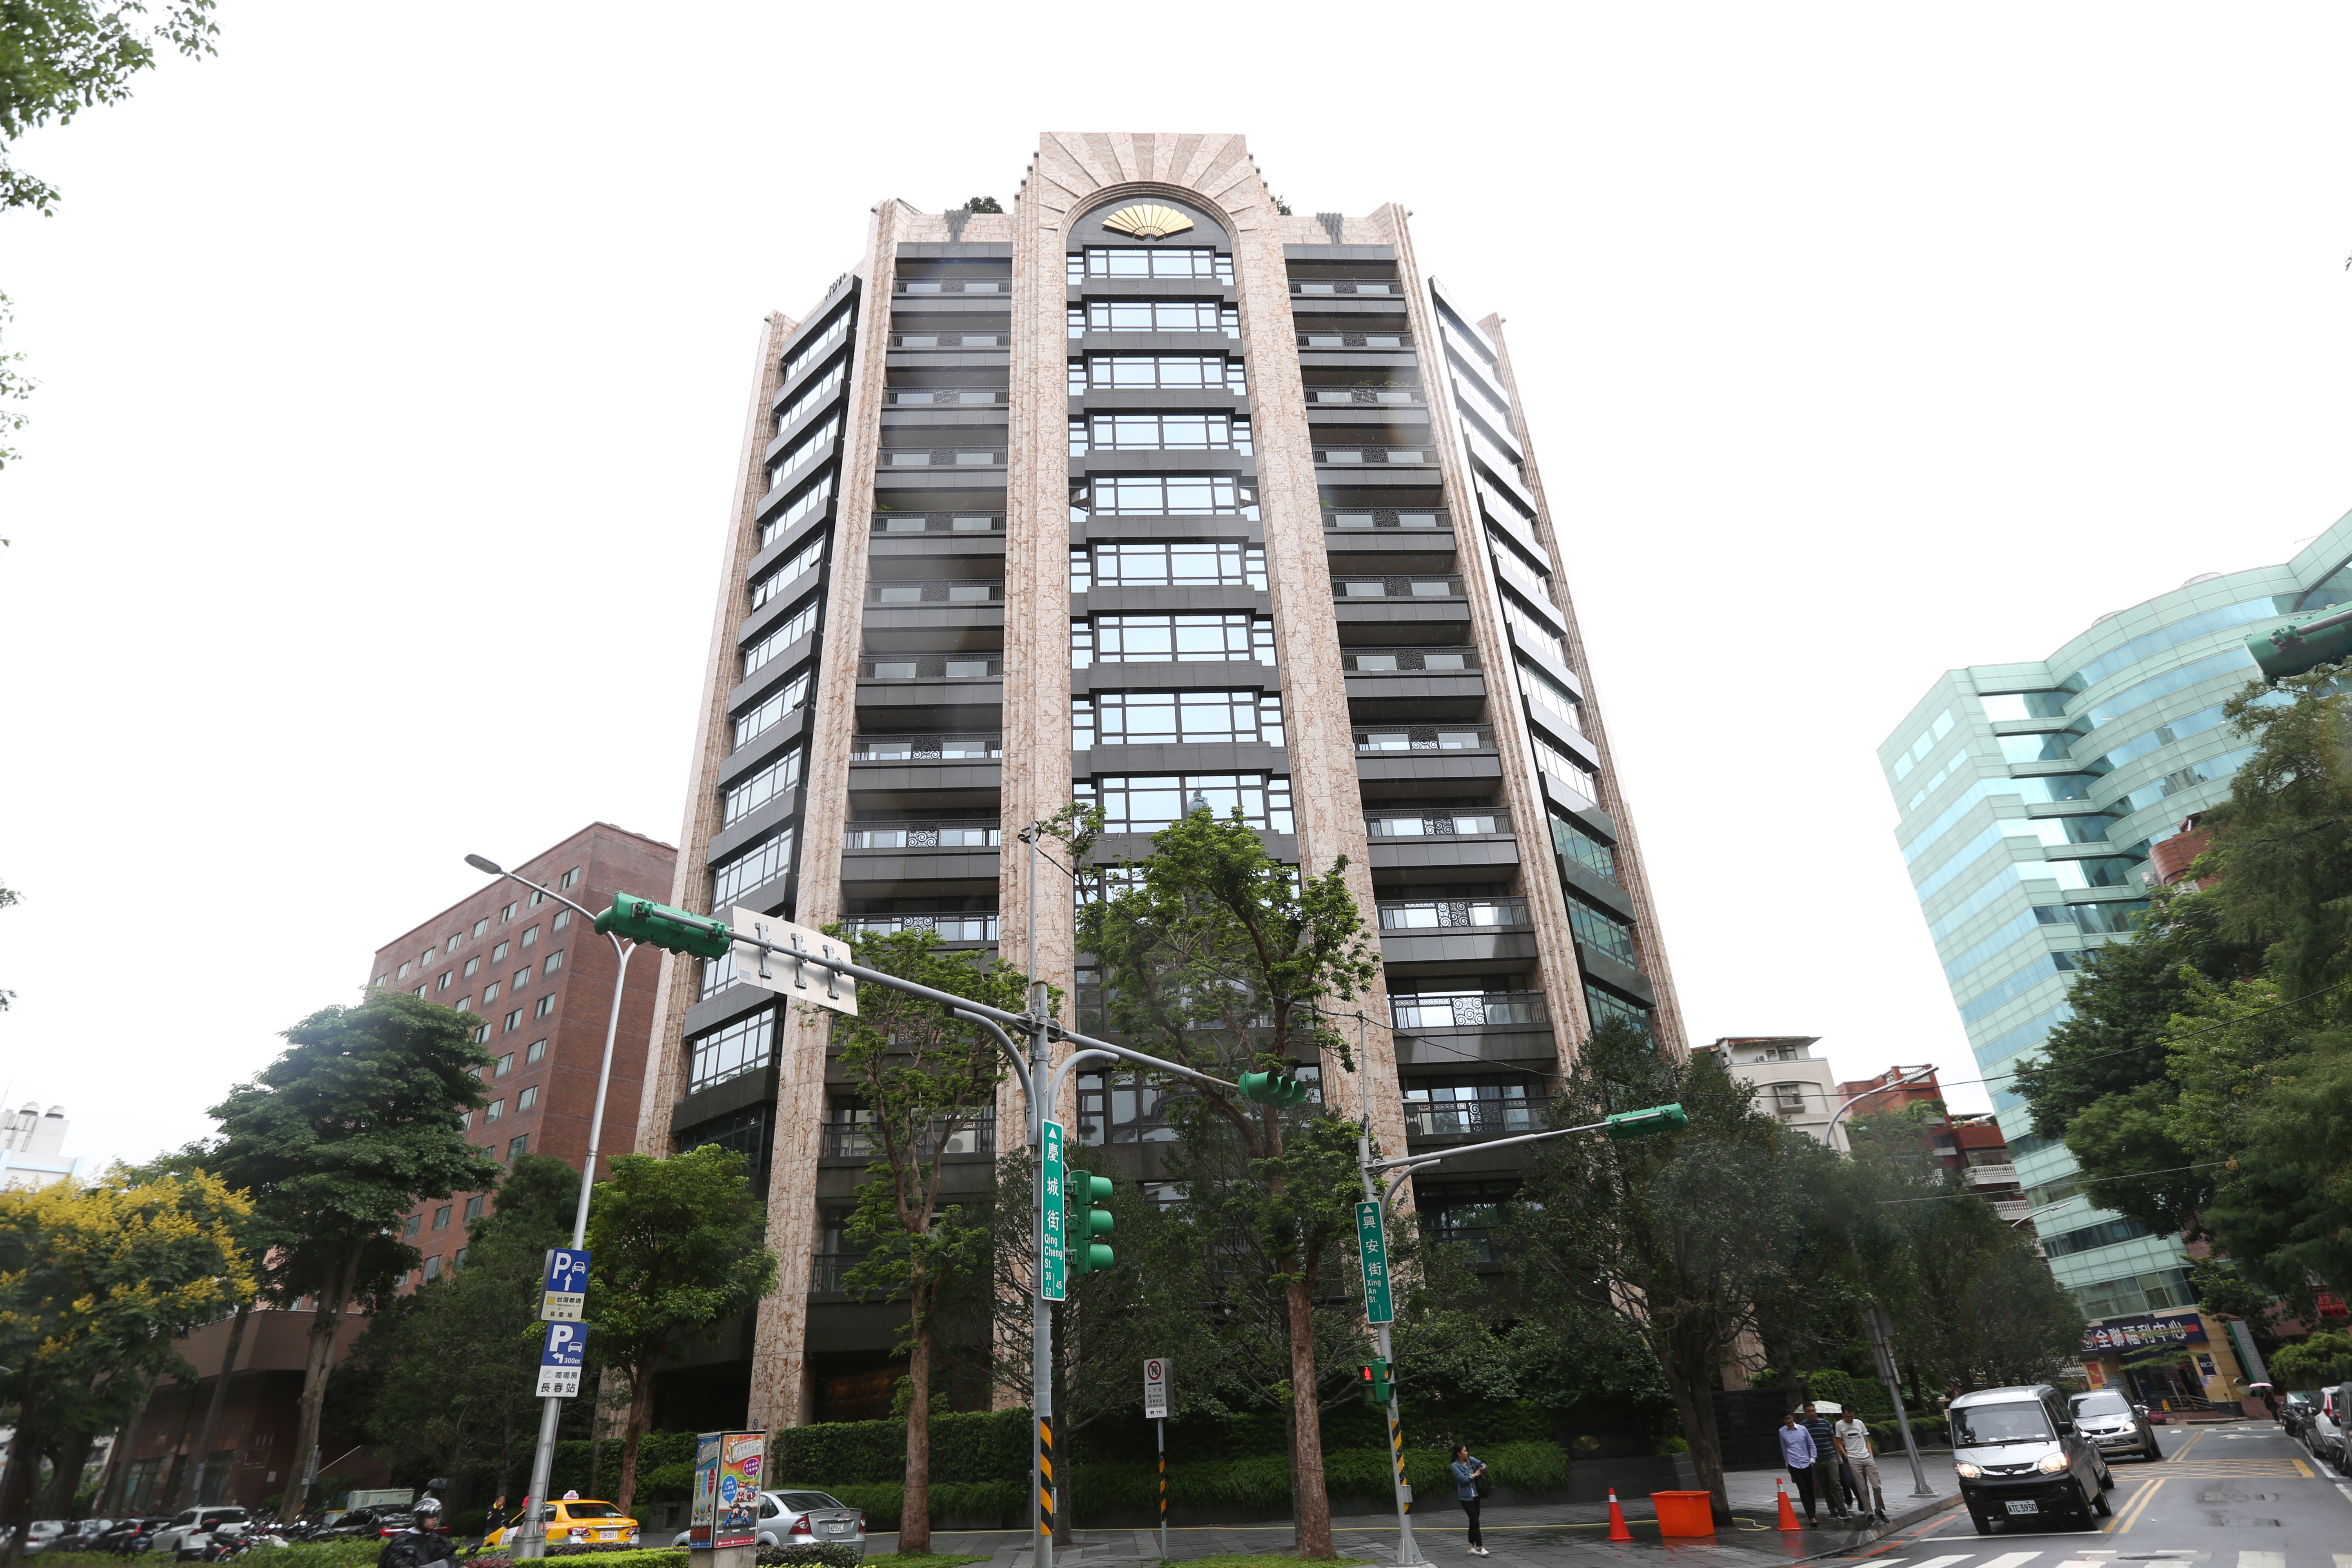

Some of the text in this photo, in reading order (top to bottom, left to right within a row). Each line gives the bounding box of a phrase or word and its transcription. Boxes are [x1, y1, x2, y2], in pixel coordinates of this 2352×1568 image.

[1047, 1142, 1060, 1231] 慶城街
[1044, 1234, 1058, 1248] Qing
[1363, 1216, 1382, 1276] 興安街
[1044, 1246, 1062, 1260] Cheng
[552, 1252, 572, 1279] P
[1044, 1258, 1053, 1269] St.
[1045, 1271, 1051, 1281] 36
[1367, 1279, 1381, 1287] Xing
[1045, 1287, 1051, 1296] 52
[1056, 1280, 1062, 1290] 45
[549, 1325, 573, 1352] P
[2095, 1320, 2187, 1348] 全聯福利中心
[2241, 1338, 2264, 1377] PARKING
[541, 1382, 576, 1393] 長春站
[2008, 1503, 2037, 1512] ATC-3930
